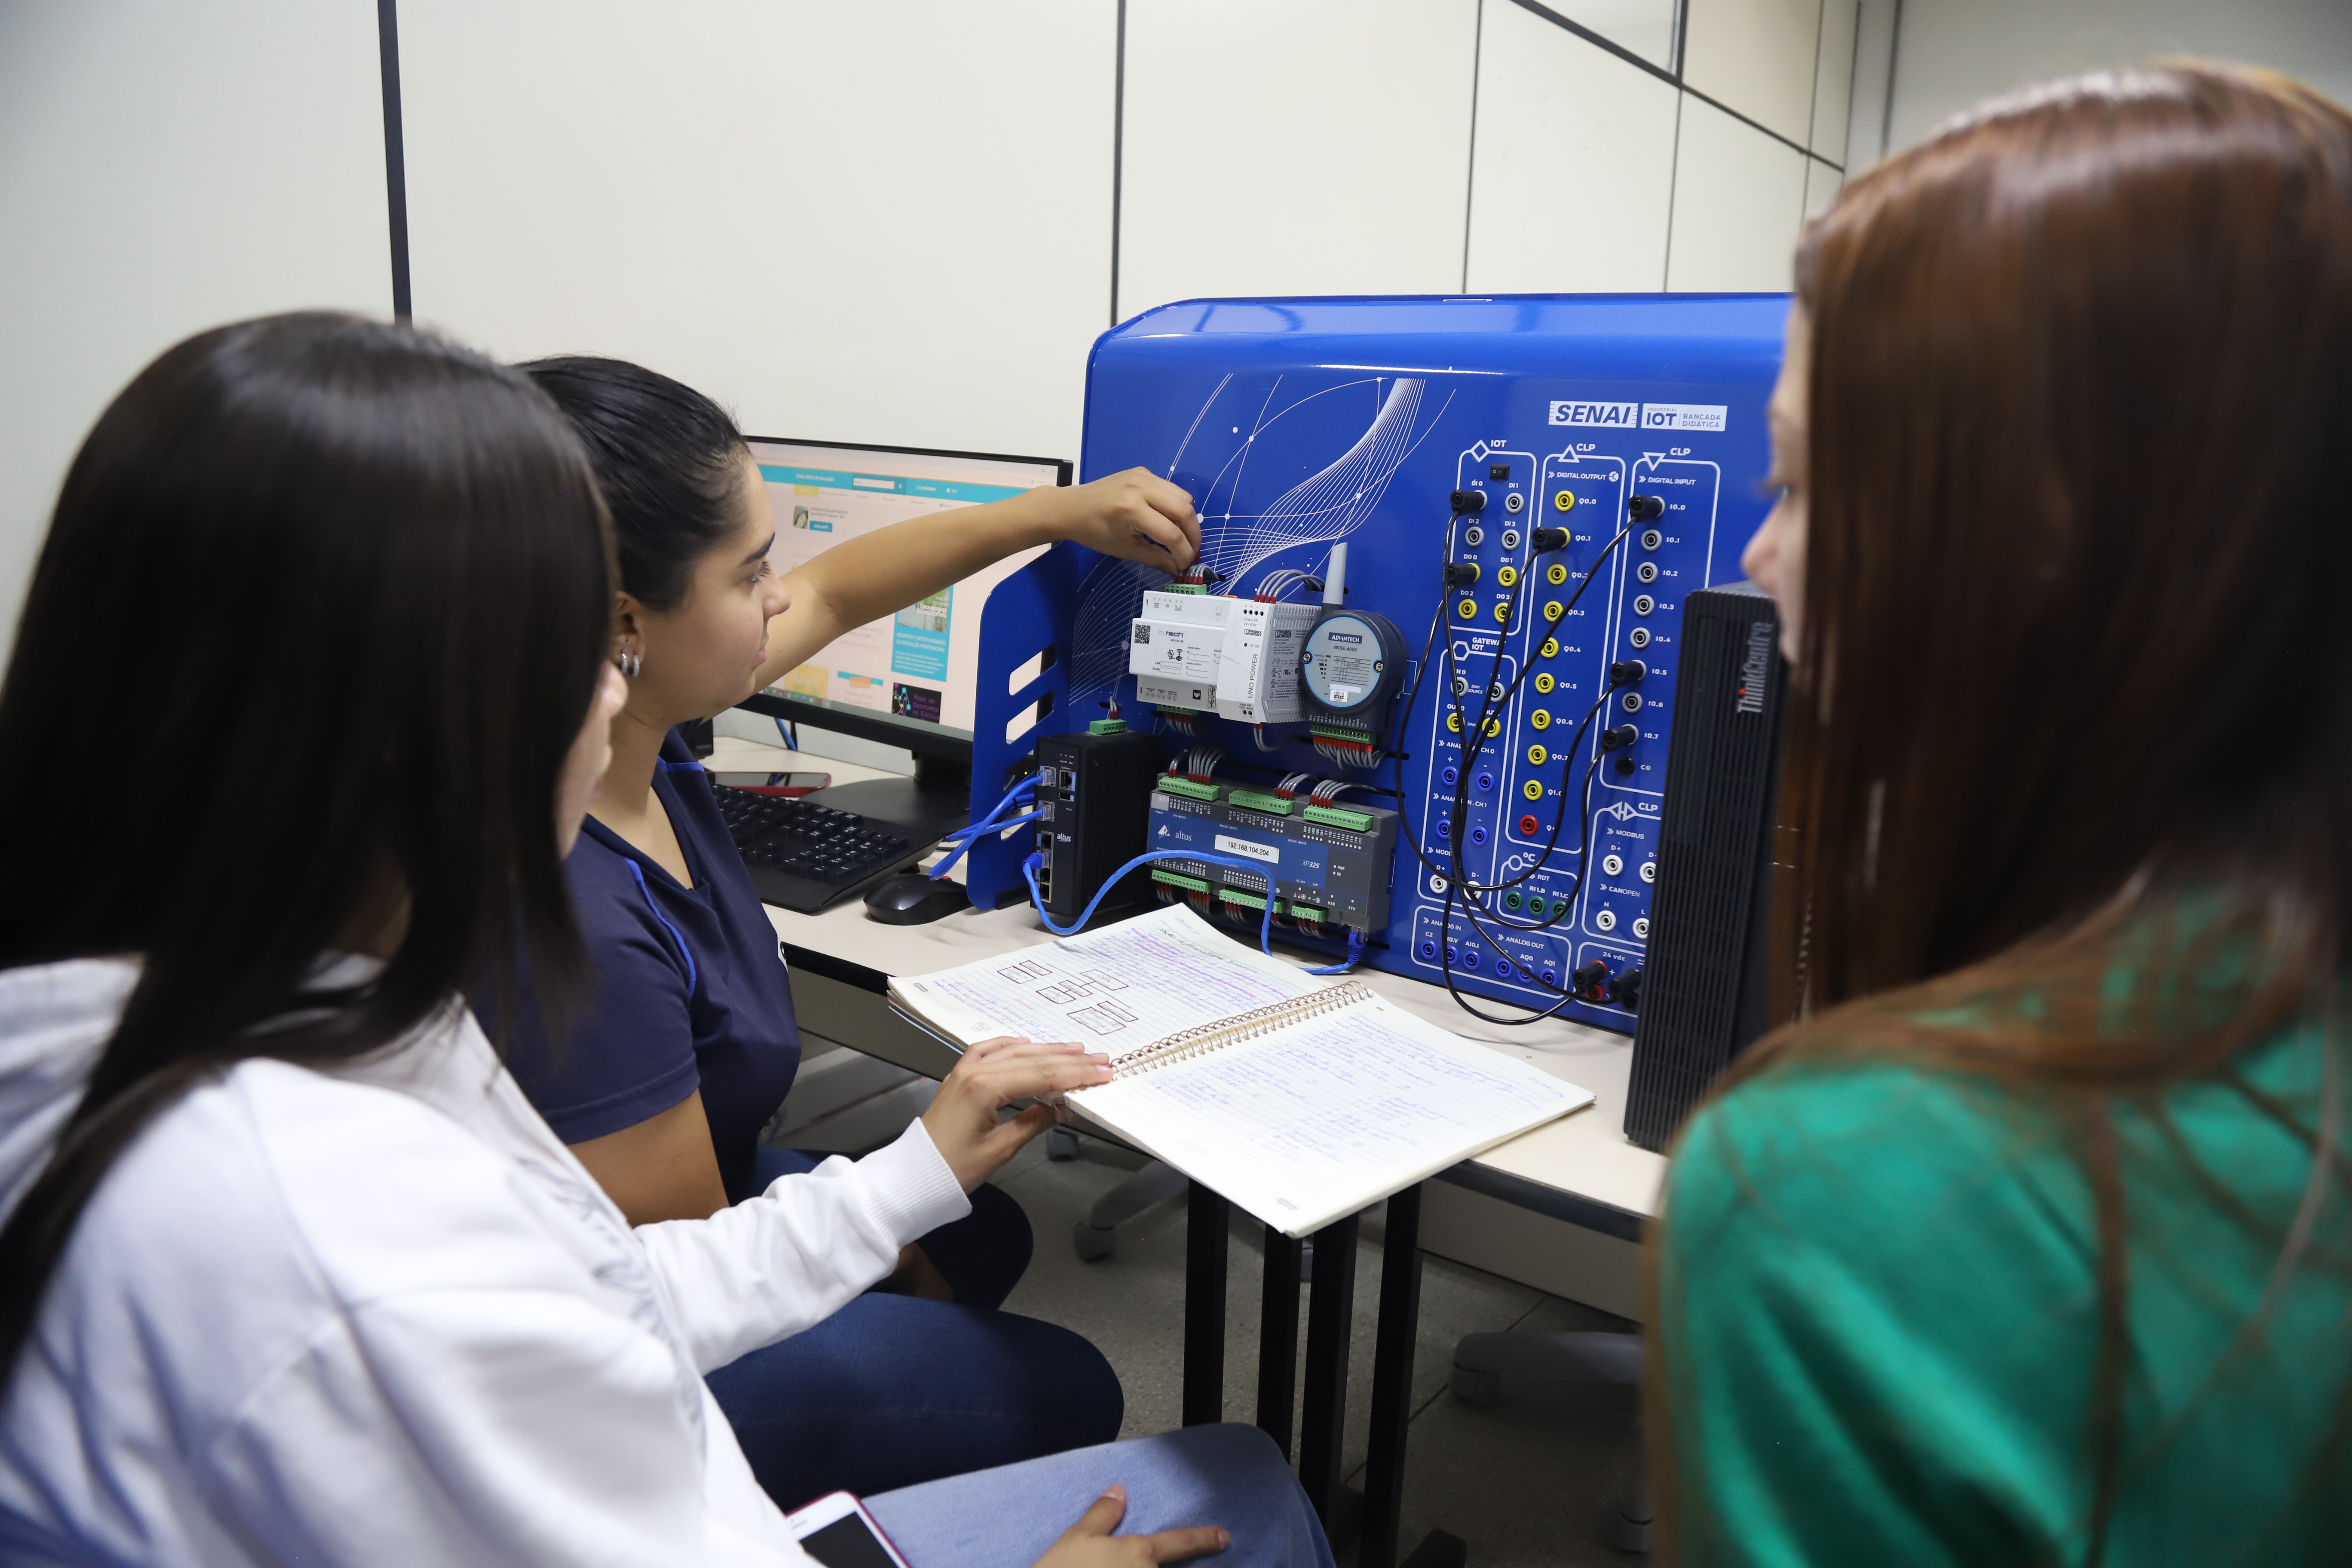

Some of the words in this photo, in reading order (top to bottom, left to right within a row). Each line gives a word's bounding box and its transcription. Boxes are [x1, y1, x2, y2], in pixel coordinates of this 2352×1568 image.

[1555, 404, 1631, 424] SENAI
[1647, 412, 1677, 426] IOT
[916, 636, 946, 645] OPORTUNIDADES
[1472, 637, 1507, 646] GATEW
[1638, 802, 1658, 812] CLP
[1057, 833, 1071, 842] altus
[1175, 831, 1192, 841] altus
[1616, 830, 1644, 839] MODBUS
[1228, 842, 1269, 856] 192.168.104.204
[1302, 860, 1320, 869] XP325
[1609, 886, 1640, 897] CANOPEN
[1431, 920, 1454, 929] ANAOG
[1506, 937, 1531, 946] ANALOG
